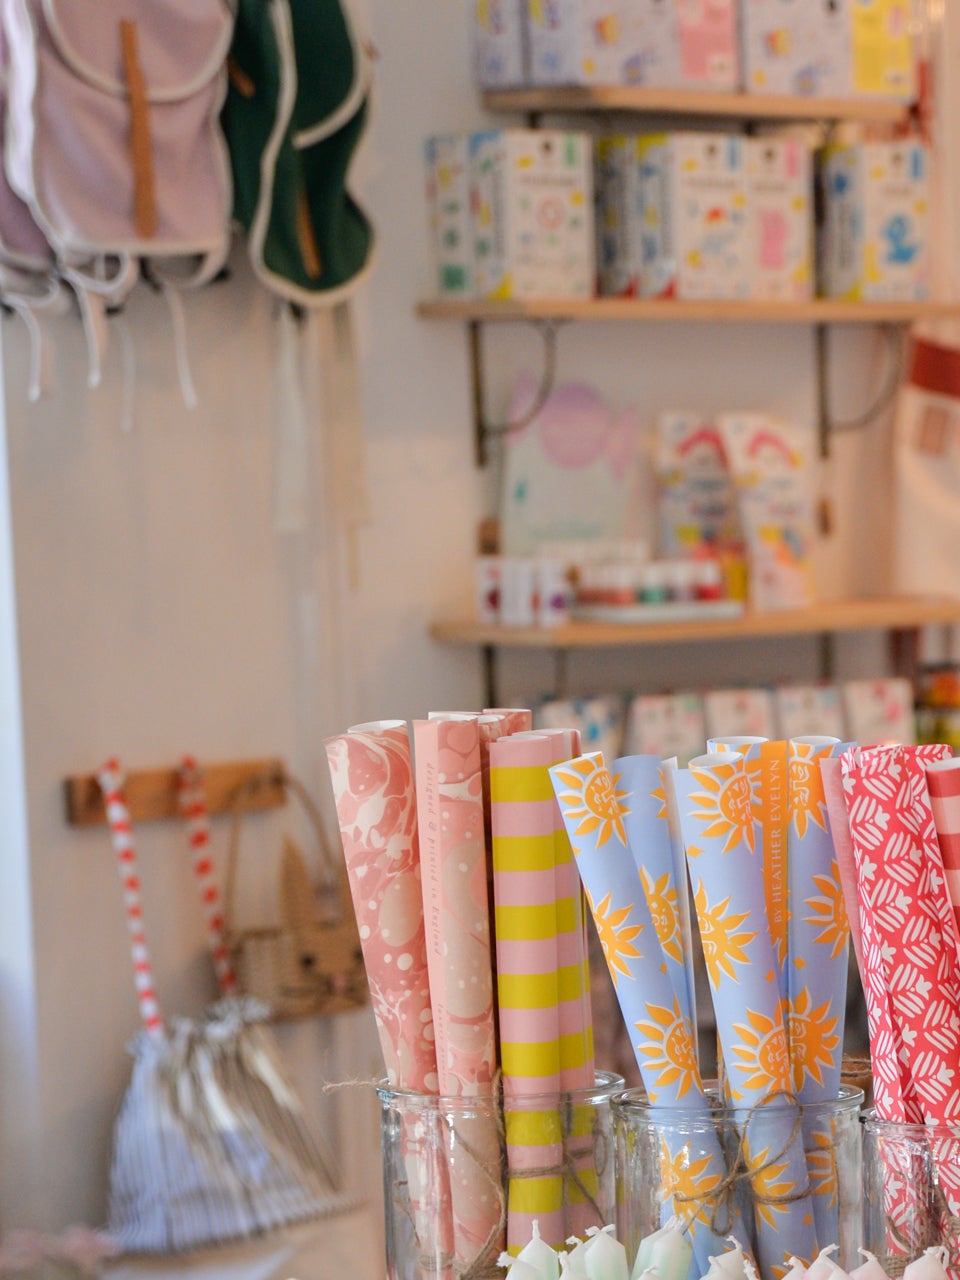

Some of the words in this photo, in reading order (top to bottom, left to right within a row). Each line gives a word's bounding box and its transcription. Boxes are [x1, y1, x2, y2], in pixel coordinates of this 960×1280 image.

[426, 762, 438, 815] designed
[769, 759, 782, 822] EVELYN
[427, 837, 439, 882] printed
[770, 828, 783, 903] HEATHER
[431, 906, 443, 958] England
[773, 908, 782, 923] BY
